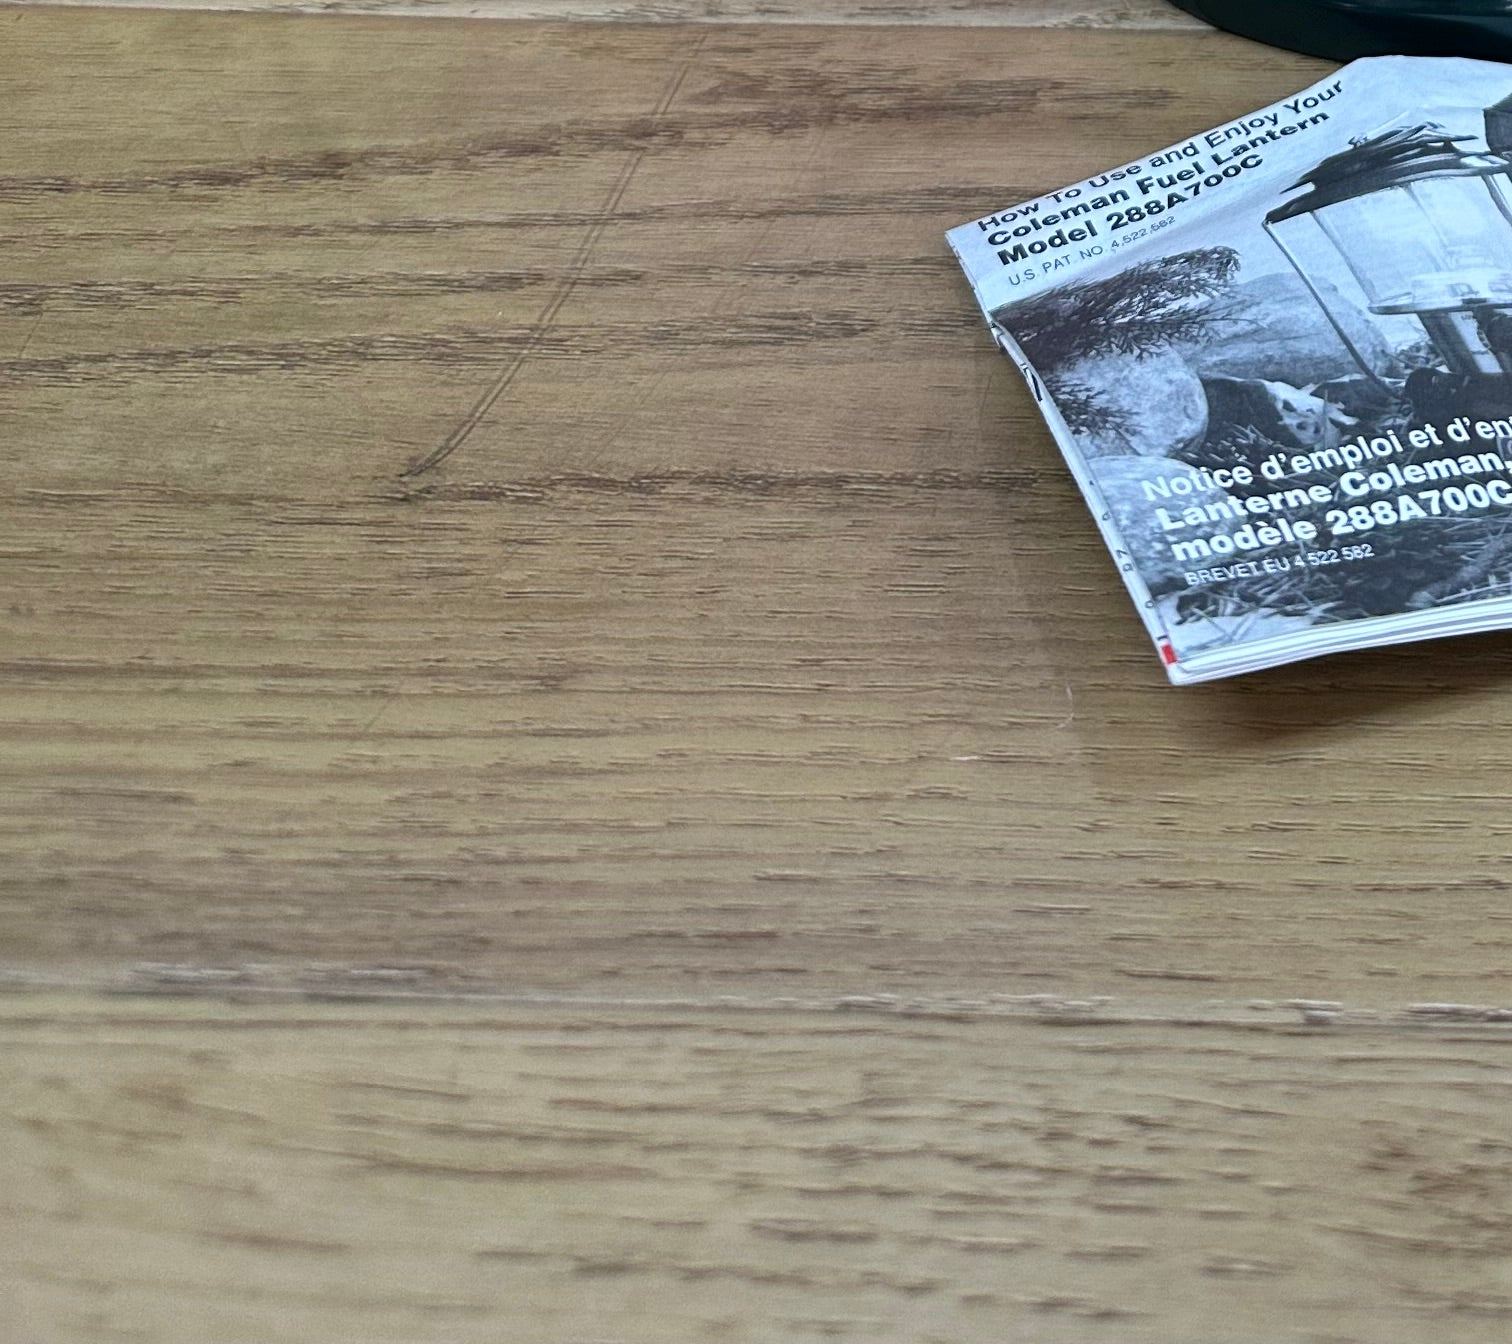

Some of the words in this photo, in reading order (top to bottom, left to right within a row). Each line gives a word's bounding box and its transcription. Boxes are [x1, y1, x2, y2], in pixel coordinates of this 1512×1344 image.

[977, 201, 1040, 233] How
[1049, 187, 1082, 205] To
[1088, 165, 1142, 189] Use
[1150, 141, 1200, 168] and
[1204, 112, 1280, 149] Enjoy
[1283, 80, 1344, 114] Your
[987, 188, 1131, 246] Coleman
[1135, 161, 1206, 195] Fuel
[1210, 111, 1330, 166] Lantern
[997, 220, 1098, 266] Model
[1106, 153, 1264, 232] 288A700C
[1008, 269, 1040, 286] U.S.
[1141, 460, 1254, 503] Notice
[1260, 428, 1404, 483] d'emploi
[1413, 421, 1438, 449] et
[1155, 483, 1334, 531] Lanterne
[1169, 517, 1317, 562] modèle
[1184, 559, 1259, 586] BREVET
[1294, 551, 1304, 567] 4
